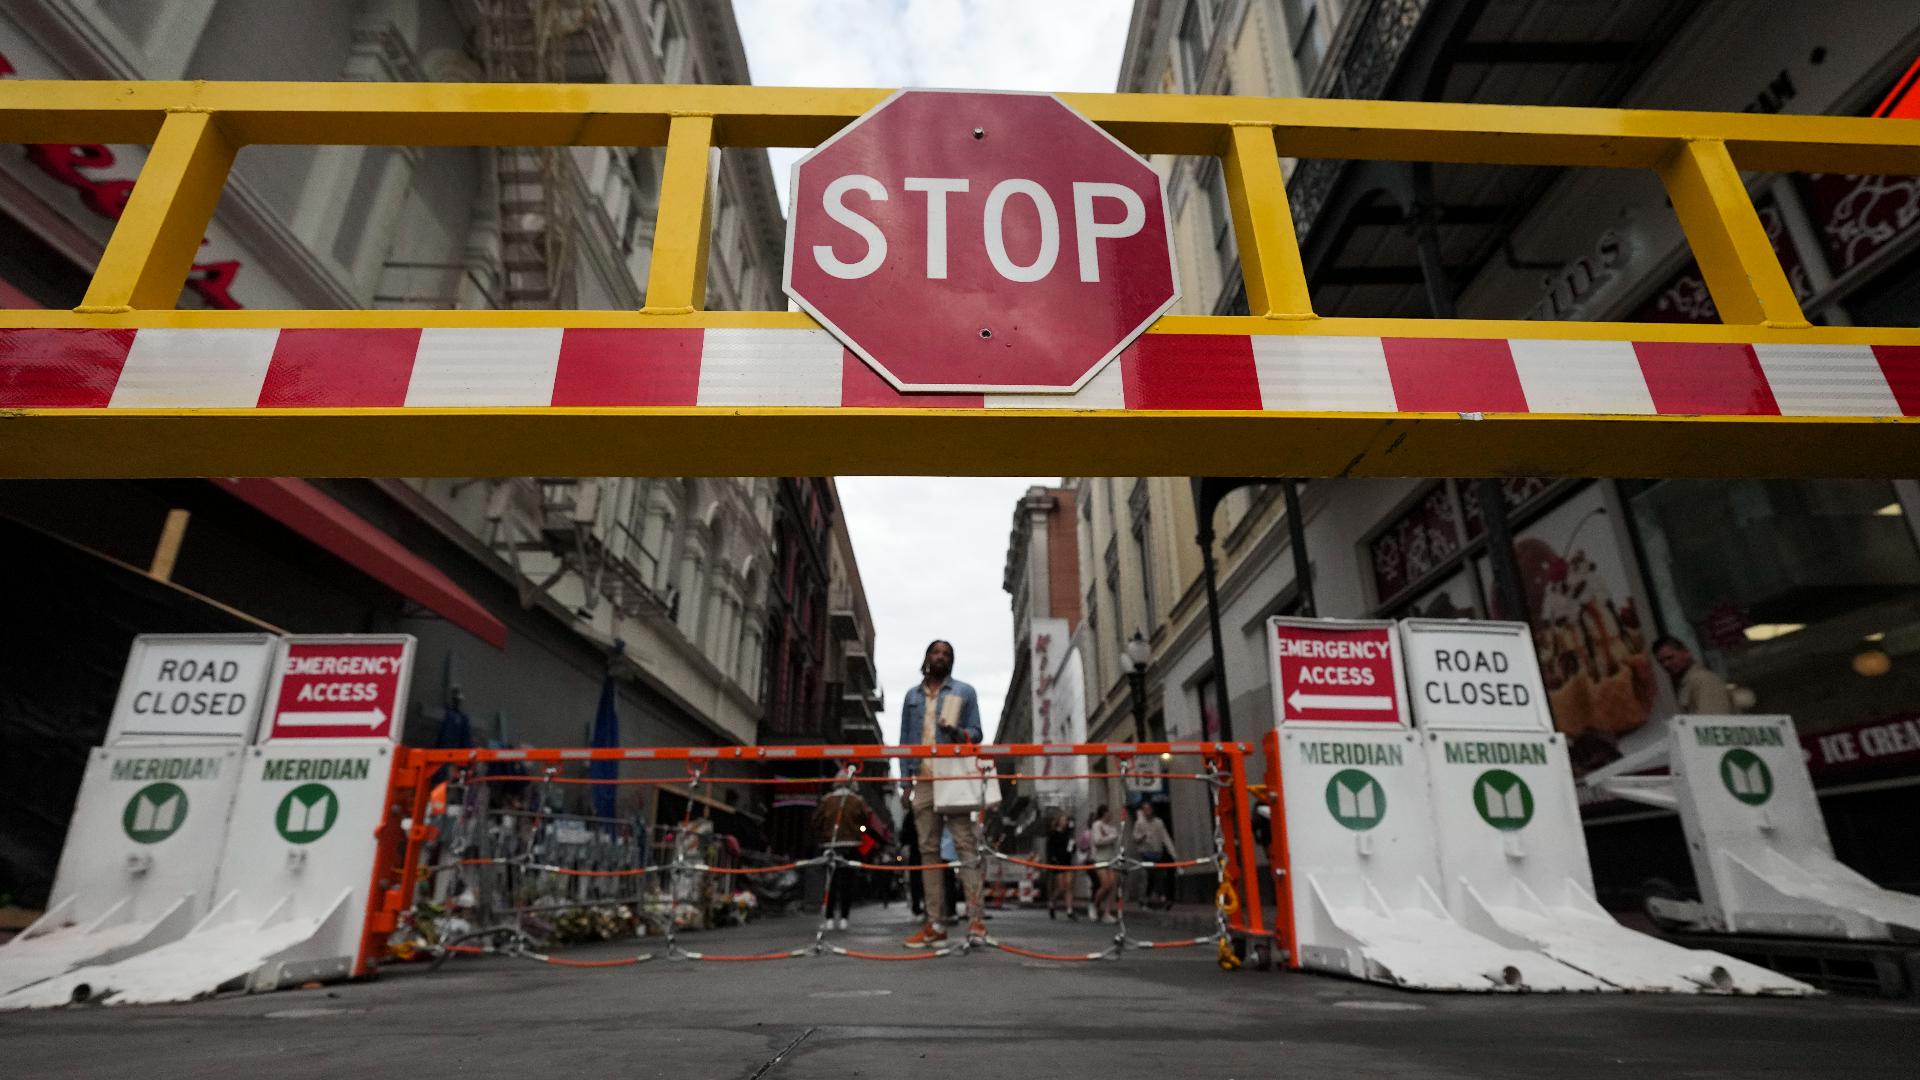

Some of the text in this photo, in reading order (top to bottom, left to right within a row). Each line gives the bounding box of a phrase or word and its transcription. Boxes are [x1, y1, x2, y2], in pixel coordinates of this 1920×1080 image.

[812, 173, 1147, 283] STOP
[1279, 638, 1391, 660] EMERGENCY
[157, 660, 239, 683] ROAD
[284, 656, 403, 676] EMERGENCY
[1435, 650, 1509, 674] ROAD
[1299, 666, 1376, 686] ACCESS
[132, 691, 247, 716] CLOSED
[297, 682, 379, 702] ACCESS
[1425, 681, 1531, 706] CLOSED
[1694, 726, 1784, 747] MERIDIAN
[1818, 718, 1920, 765] ICE CREA
[1300, 742, 1404, 766] MERIDIAN
[1444, 742, 1548, 765] MERIDIAN
[110, 757, 222, 782] MERIDIAN
[261, 757, 371, 781] MERIDIAN
